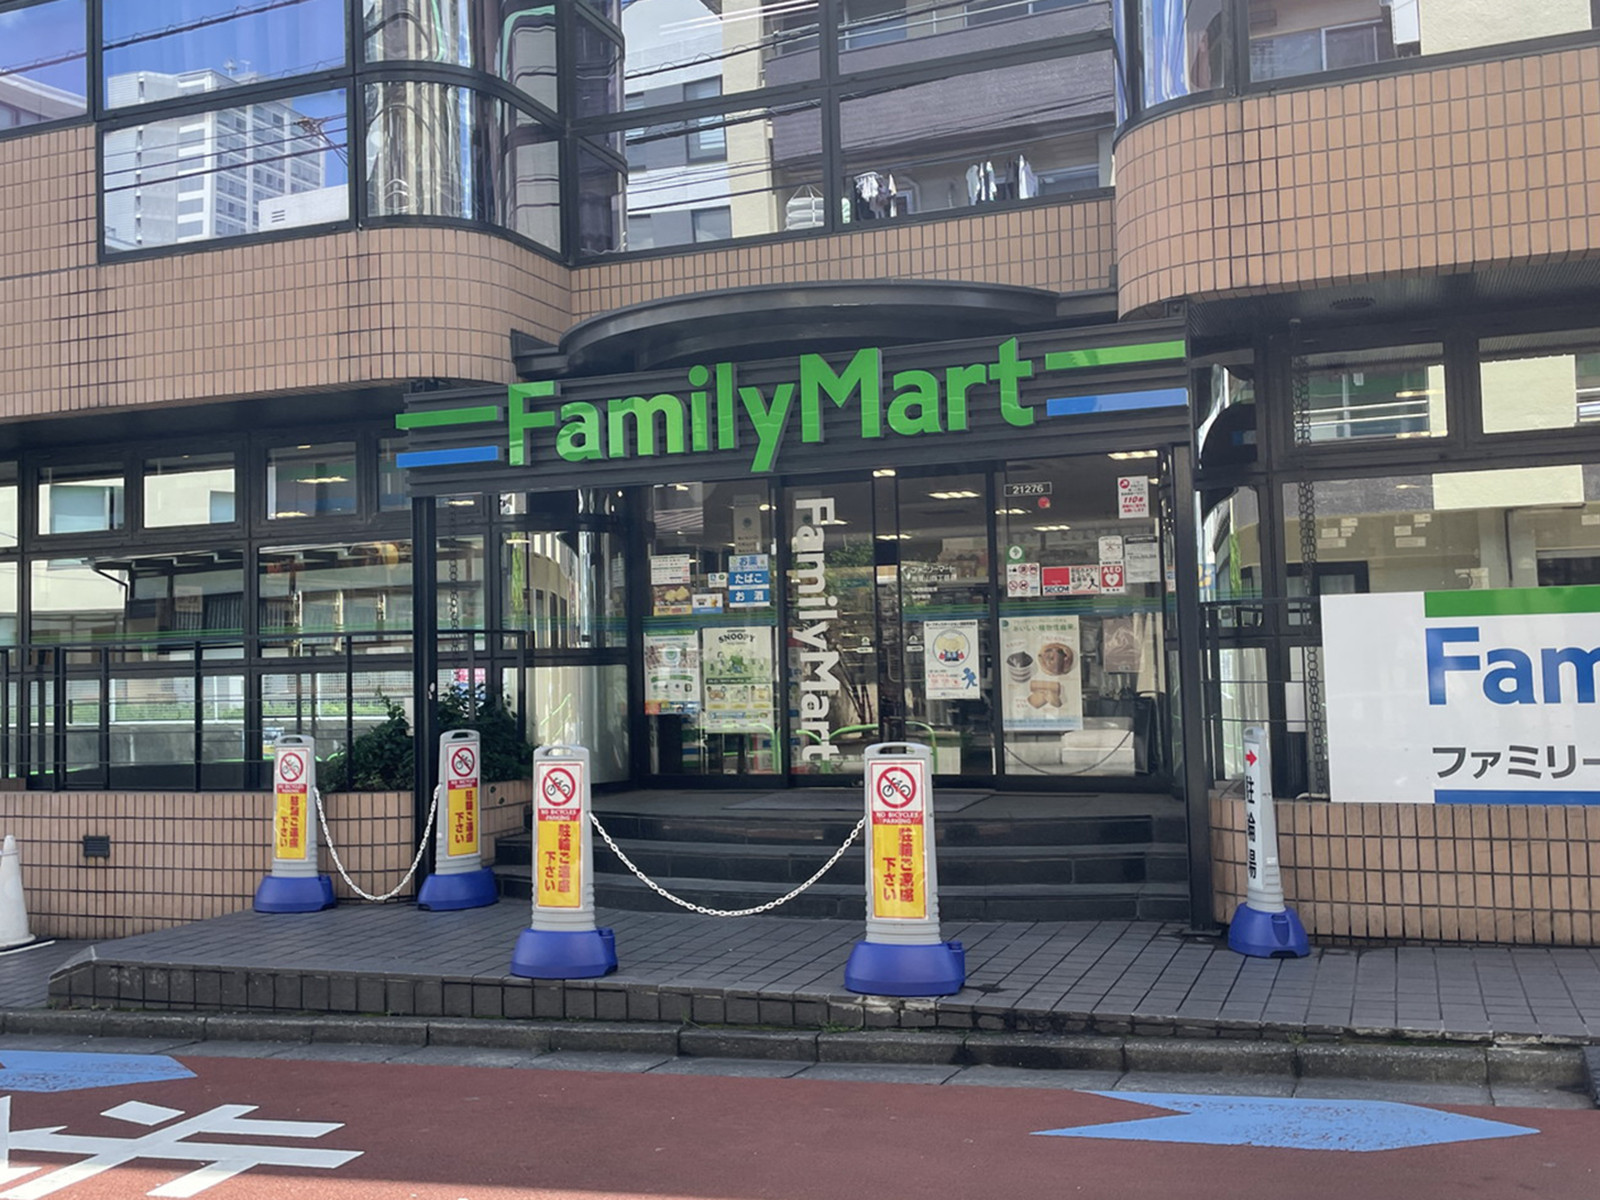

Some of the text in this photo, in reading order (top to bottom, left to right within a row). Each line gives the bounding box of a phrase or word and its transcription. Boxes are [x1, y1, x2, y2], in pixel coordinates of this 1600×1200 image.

[508, 337, 1035, 473] FamilyMart
[1011, 484, 1044, 494] 21276
[735, 573, 763, 584] たばこ
[1103, 566, 1121, 574] AED
[1044, 585, 1069, 593] SECOM
[718, 633, 755, 644] SNOOPY
[792, 498, 841, 762] FamilyMart
[1425, 626, 1600, 706] Fam
[1432, 745, 1600, 779] ファミリー
[544, 851, 556, 892] 下さい
[882, 857, 897, 901] 下さい
